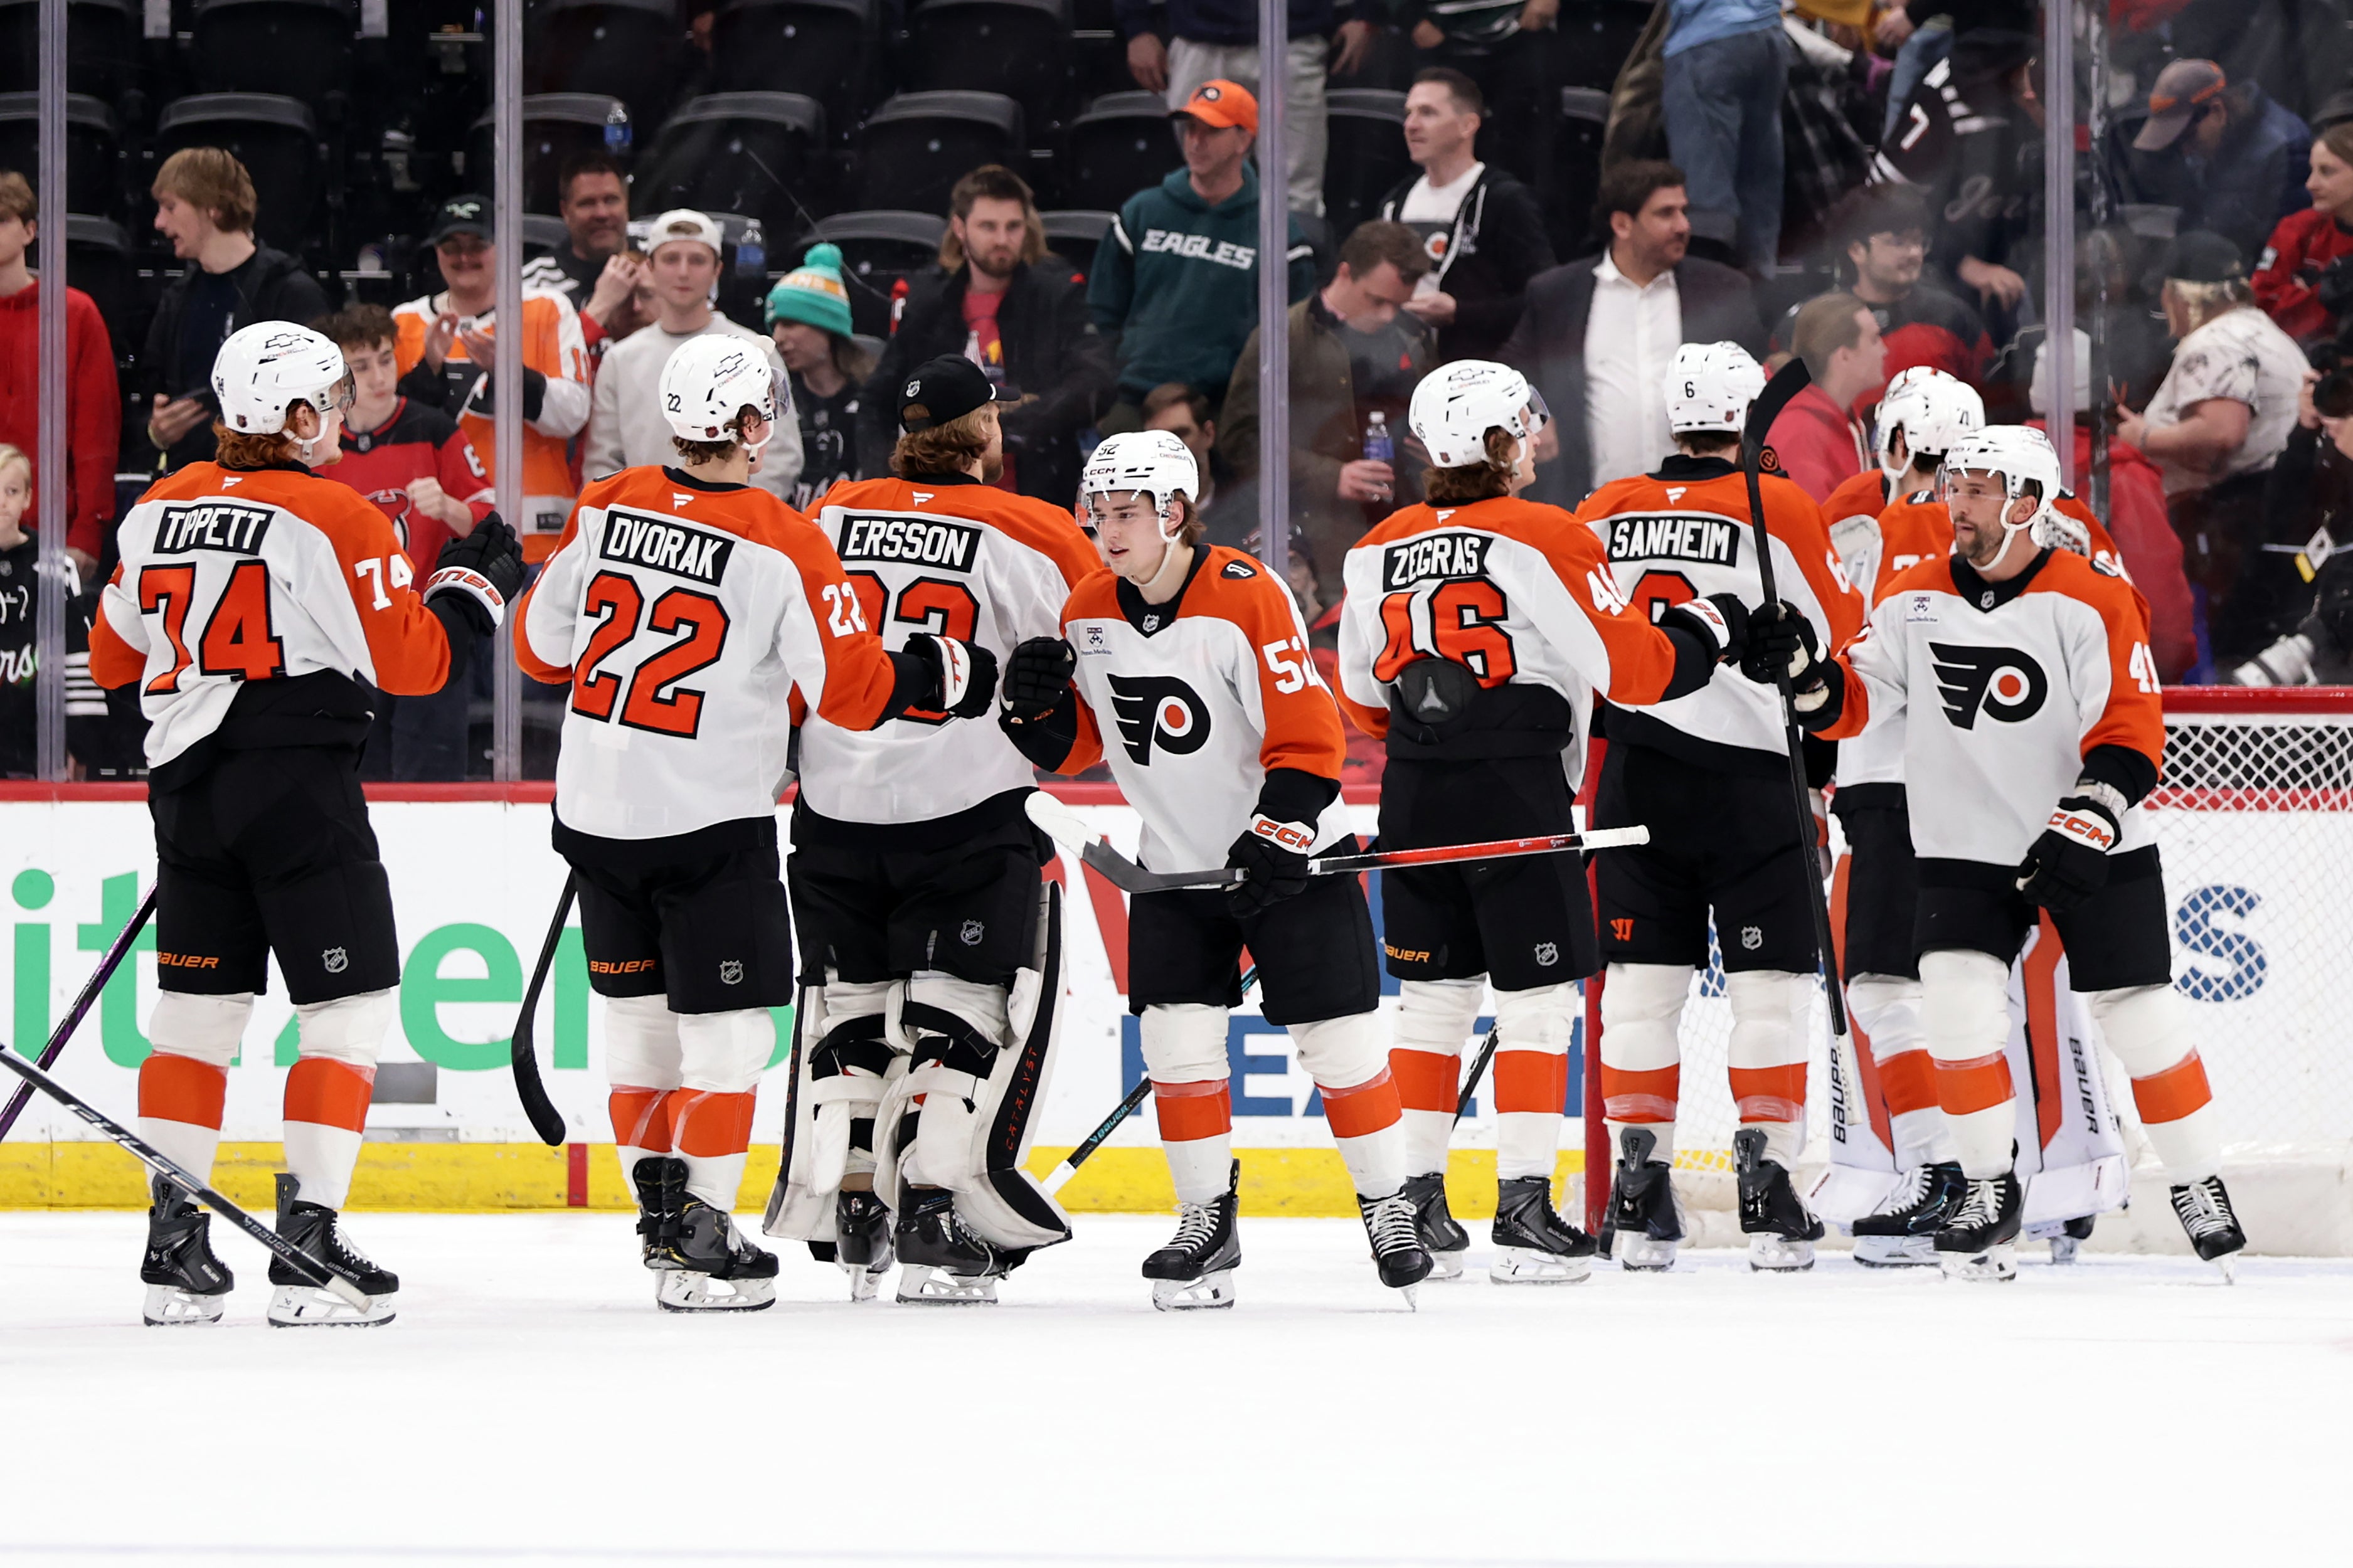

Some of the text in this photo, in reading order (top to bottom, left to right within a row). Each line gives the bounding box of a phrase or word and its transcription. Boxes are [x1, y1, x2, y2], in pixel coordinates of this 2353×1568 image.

[1140, 228, 1256, 270] EAGLES
[667, 393, 681, 413] 22
[1685, 381, 1694, 398] 6
[1098, 443, 1120, 456] 52
[162, 507, 267, 550] TIPPETT
[607, 517, 723, 578] DVORAK
[845, 520, 970, 566] ERSSON
[1612, 520, 1731, 562] SANHEIM
[354, 554, 413, 610] 74
[1390, 536, 1482, 586] ZEGRAS
[139, 560, 287, 696] 74
[1374, 577, 1517, 689] 46
[571, 569, 730, 739] 22
[2048, 813, 2112, 847] CCM
[590, 959, 656, 973] BAUER
[2069, 1036, 2099, 1135] BAUER
